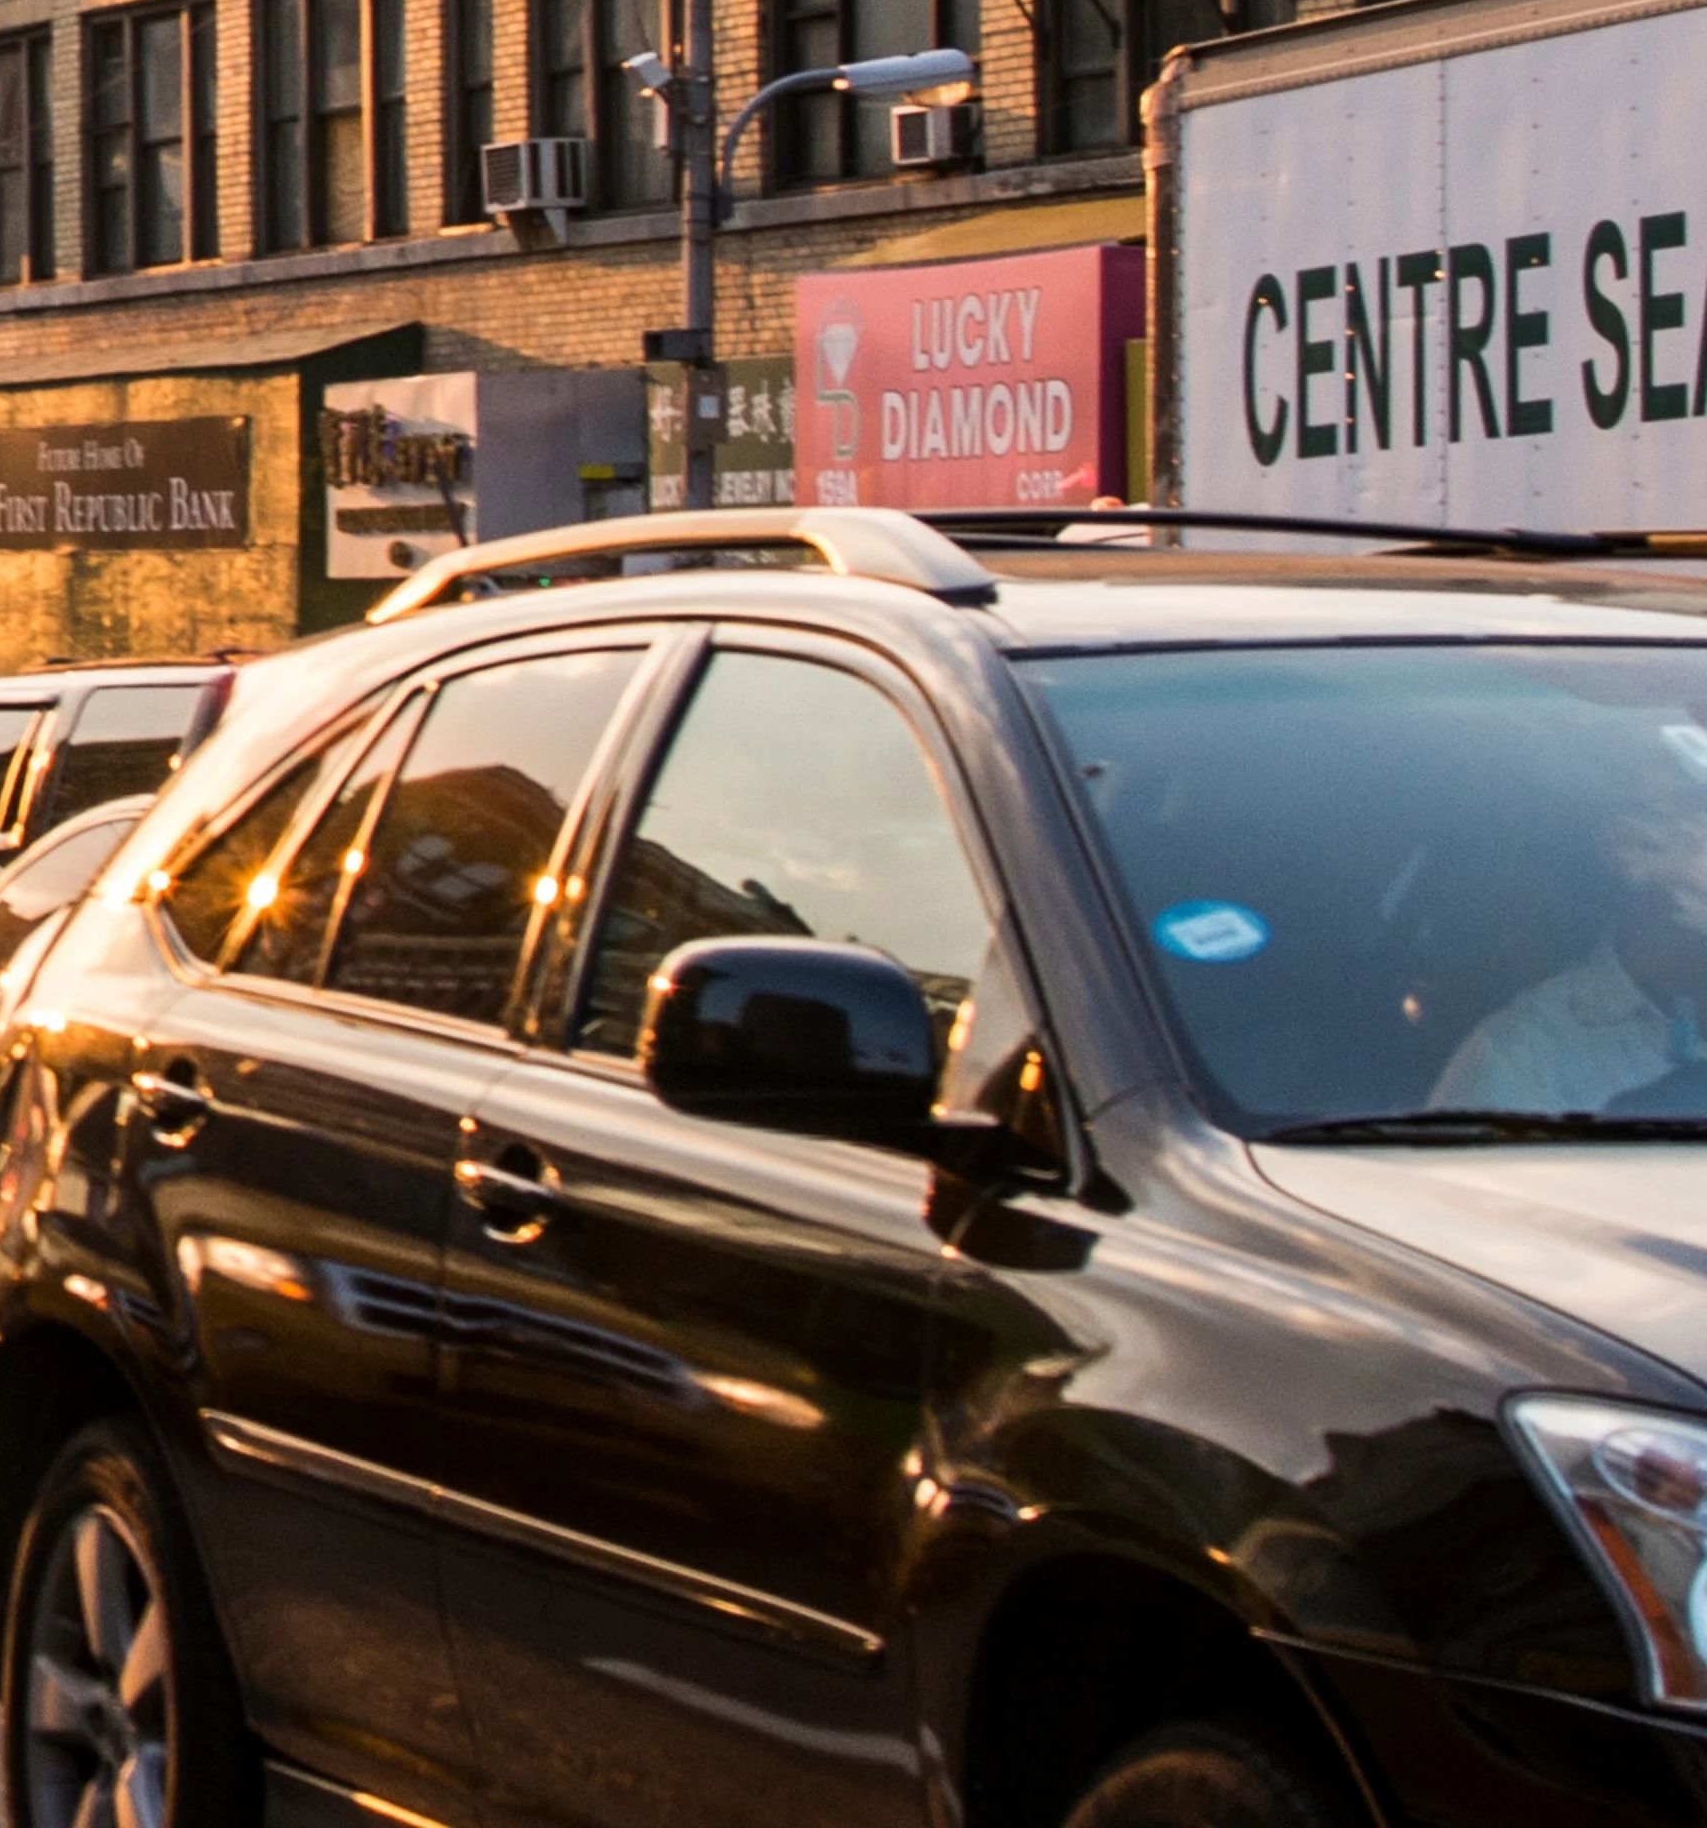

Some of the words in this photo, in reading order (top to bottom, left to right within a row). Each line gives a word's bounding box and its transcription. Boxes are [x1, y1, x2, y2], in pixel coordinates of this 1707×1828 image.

[912, 286, 1042, 372] LUCKY
[1243, 232, 1554, 466] CENTRE
[1581, 210, 1707, 430] SE
[881, 379, 1073, 462] DIAMOND
[53, 480, 164, 533] REPUBLIC
[169, 476, 236, 530] BANK
